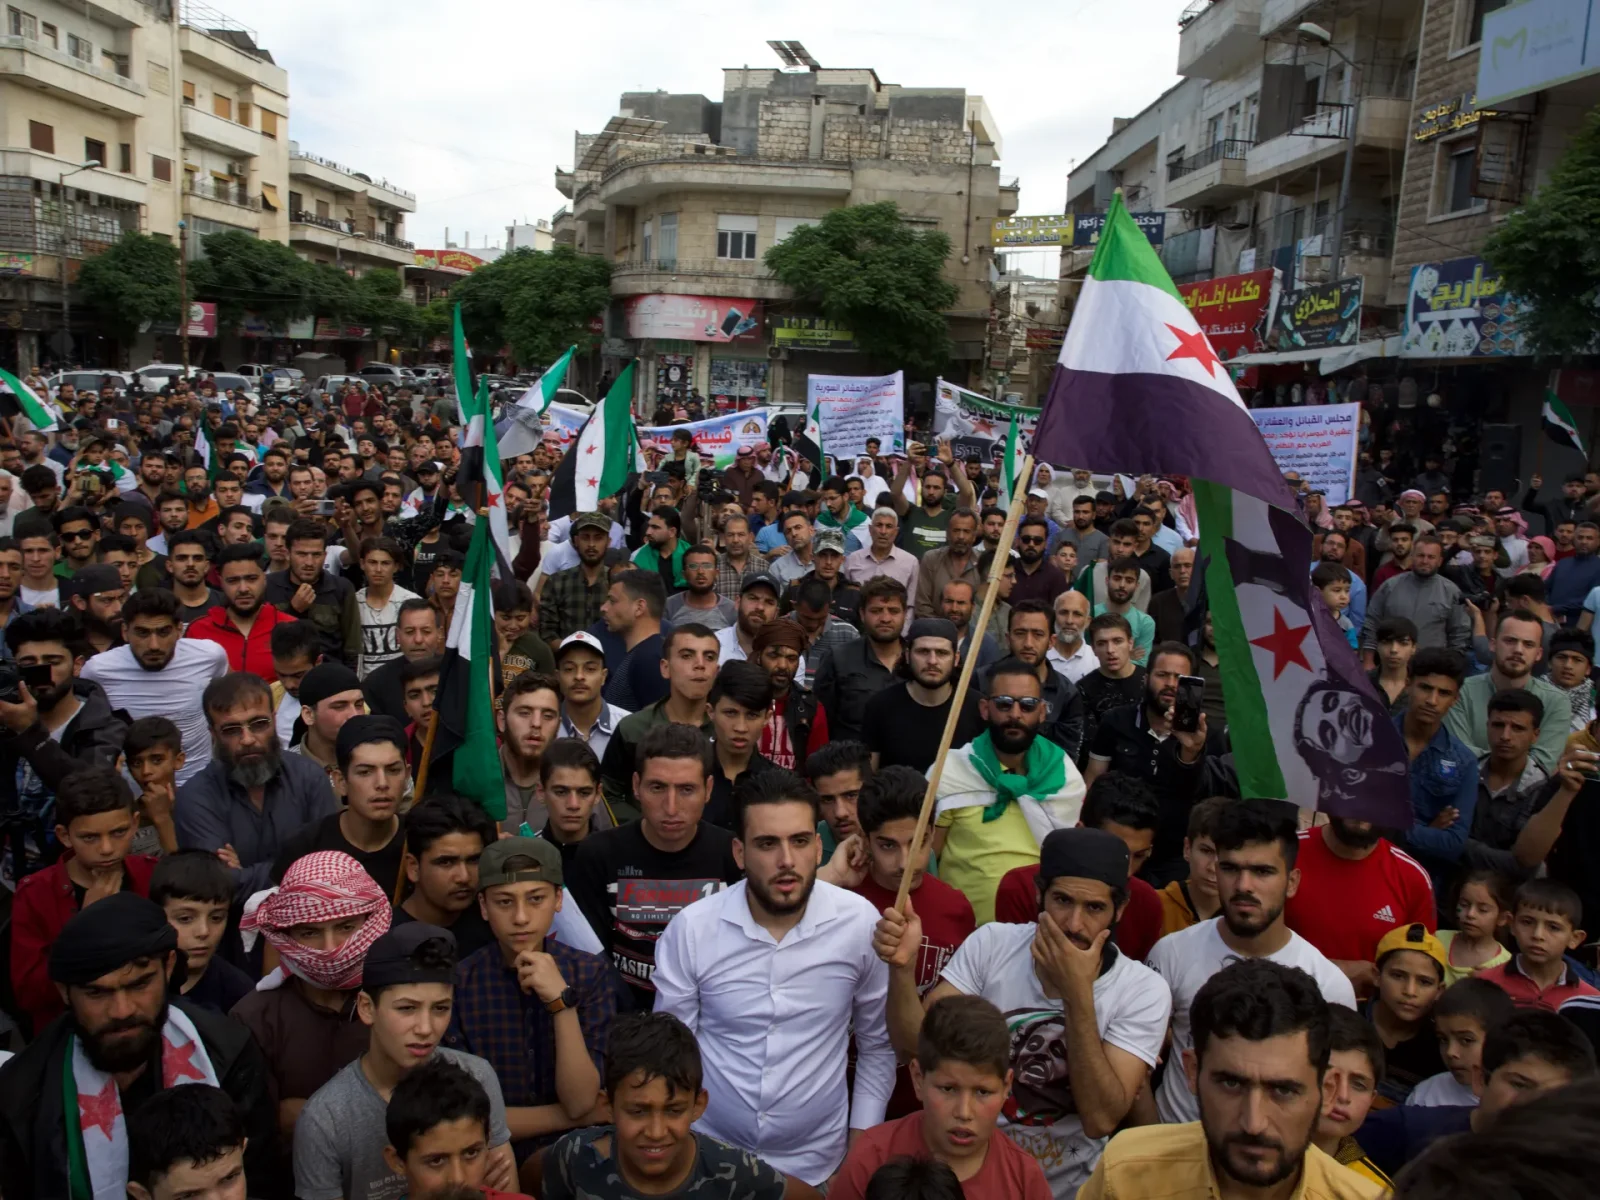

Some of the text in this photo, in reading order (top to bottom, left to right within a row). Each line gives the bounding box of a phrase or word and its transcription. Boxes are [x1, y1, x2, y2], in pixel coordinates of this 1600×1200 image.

[782, 317, 809, 328] TOP
[815, 382, 841, 394] السورية
[1264, 416, 1294, 429] والعشائر
[1296, 415, 1322, 427] القبائل
[1325, 414, 1352, 425] مجلس
[692, 425, 732, 449] قبيلة
[1329, 427, 1352, 438] عشيرة
[1275, 442, 1294, 451] النظام
[1296, 442, 1307, 451] مع
[1308, 440, 1332, 450] العربي
[612, 950, 656, 980] FASHI
